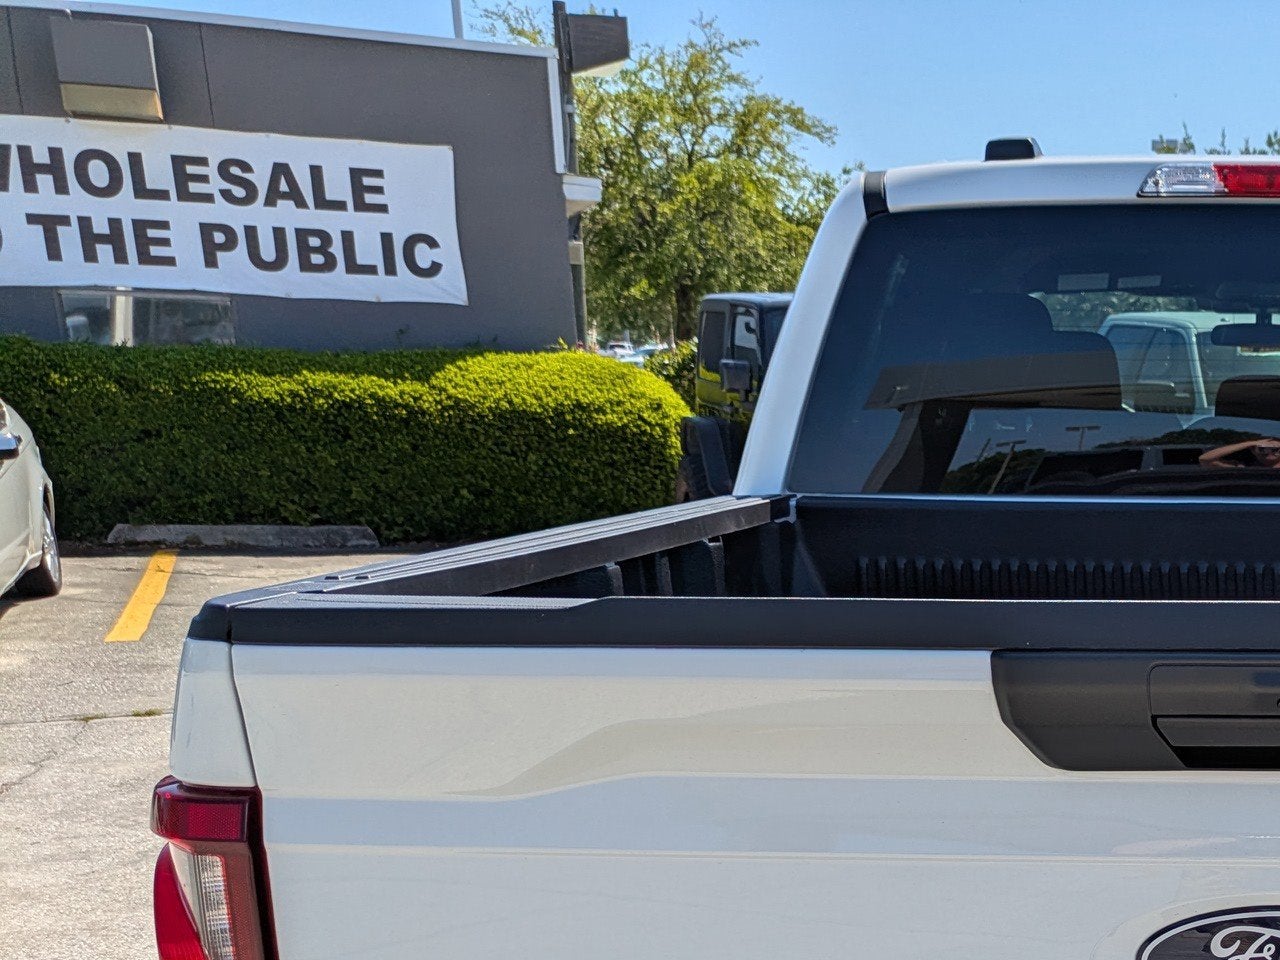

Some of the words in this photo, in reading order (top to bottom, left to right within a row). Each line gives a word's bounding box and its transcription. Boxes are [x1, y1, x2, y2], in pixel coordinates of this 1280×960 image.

[0, 144, 390, 214] HOLESALE
[25, 212, 178, 267] THE
[199, 222, 444, 279] PUBLIC
